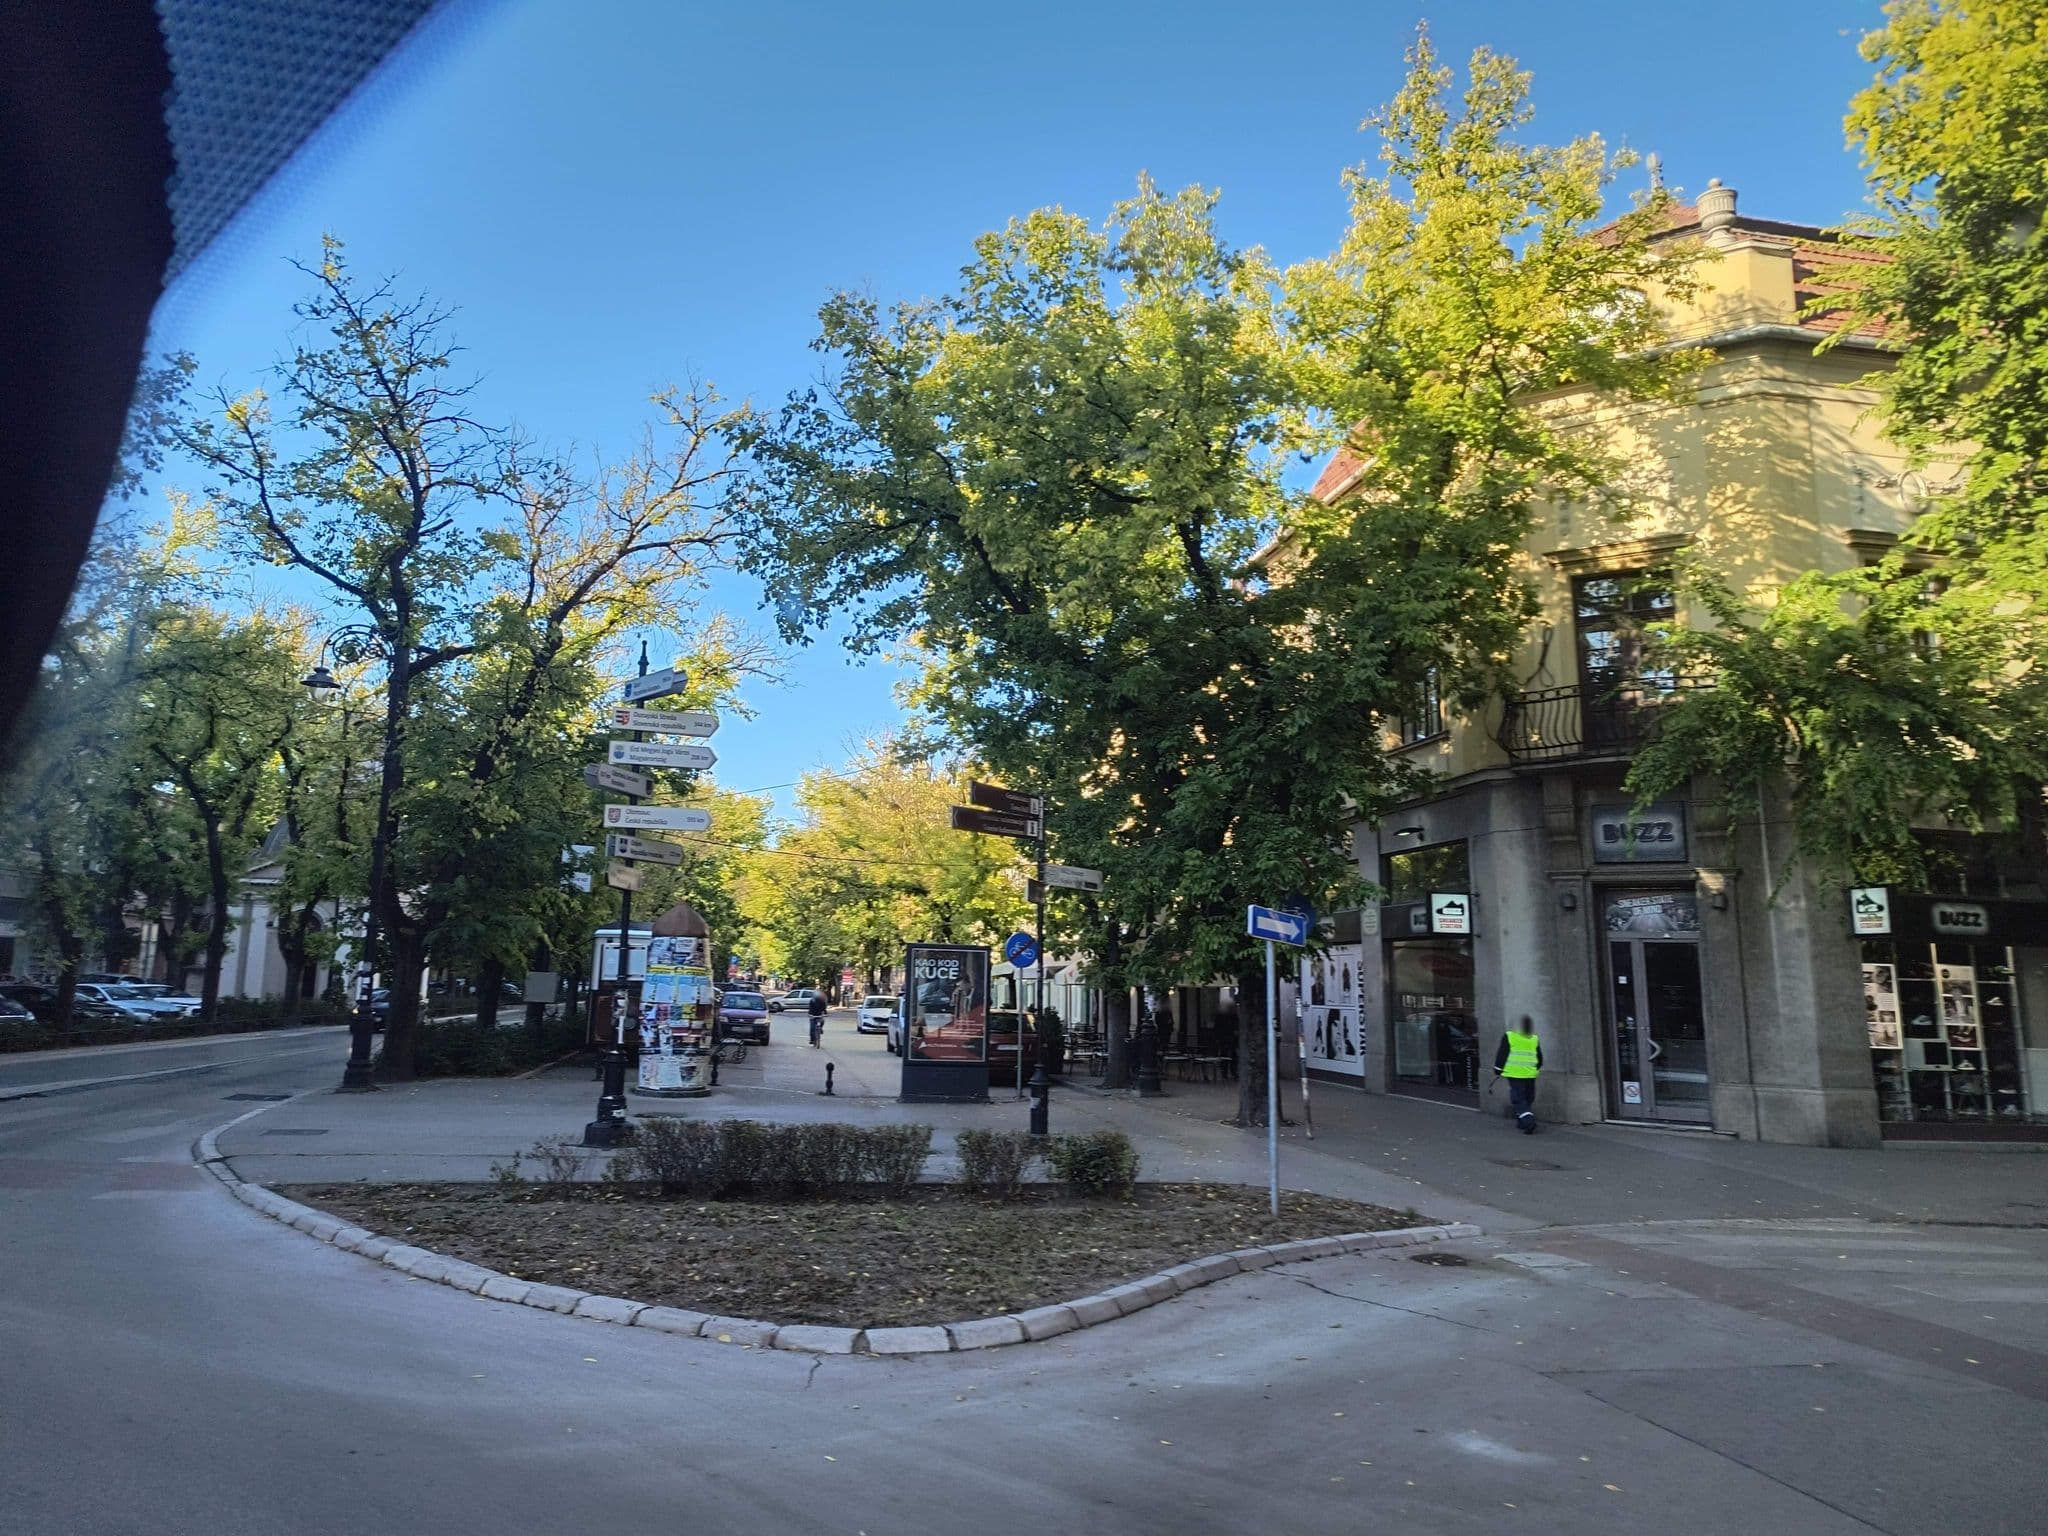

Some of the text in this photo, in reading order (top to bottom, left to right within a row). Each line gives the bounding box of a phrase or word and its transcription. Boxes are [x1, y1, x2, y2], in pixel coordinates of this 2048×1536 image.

[1939, 910, 1982, 927] BUZZ
[914, 958, 960, 968] KAO KOD
